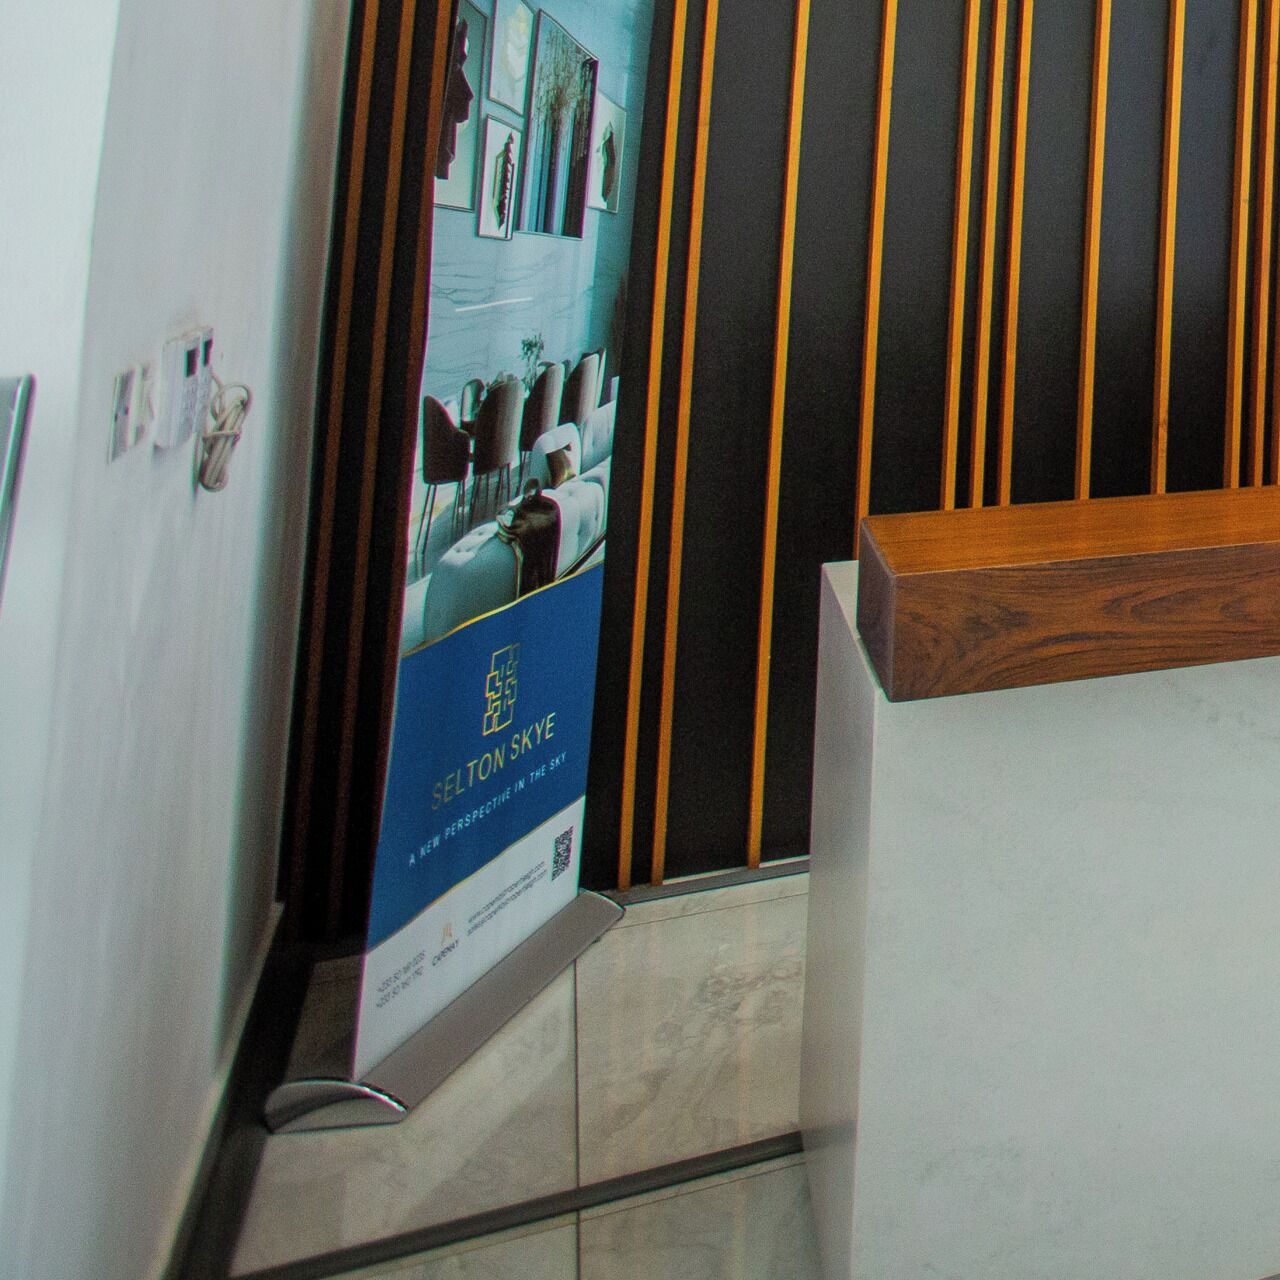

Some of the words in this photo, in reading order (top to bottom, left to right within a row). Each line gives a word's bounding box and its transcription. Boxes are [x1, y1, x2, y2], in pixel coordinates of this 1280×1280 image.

[409, 853, 416, 867] A
[420, 833, 441, 859] NEW
[445, 787, 512, 841] PERSPECTIVE
[514, 777, 525, 793] IN
[530, 764, 546, 784] THE
[549, 751, 567, 771] SKY
[432, 743, 506, 811] SELTON
[510, 712, 556, 761] SKYE
